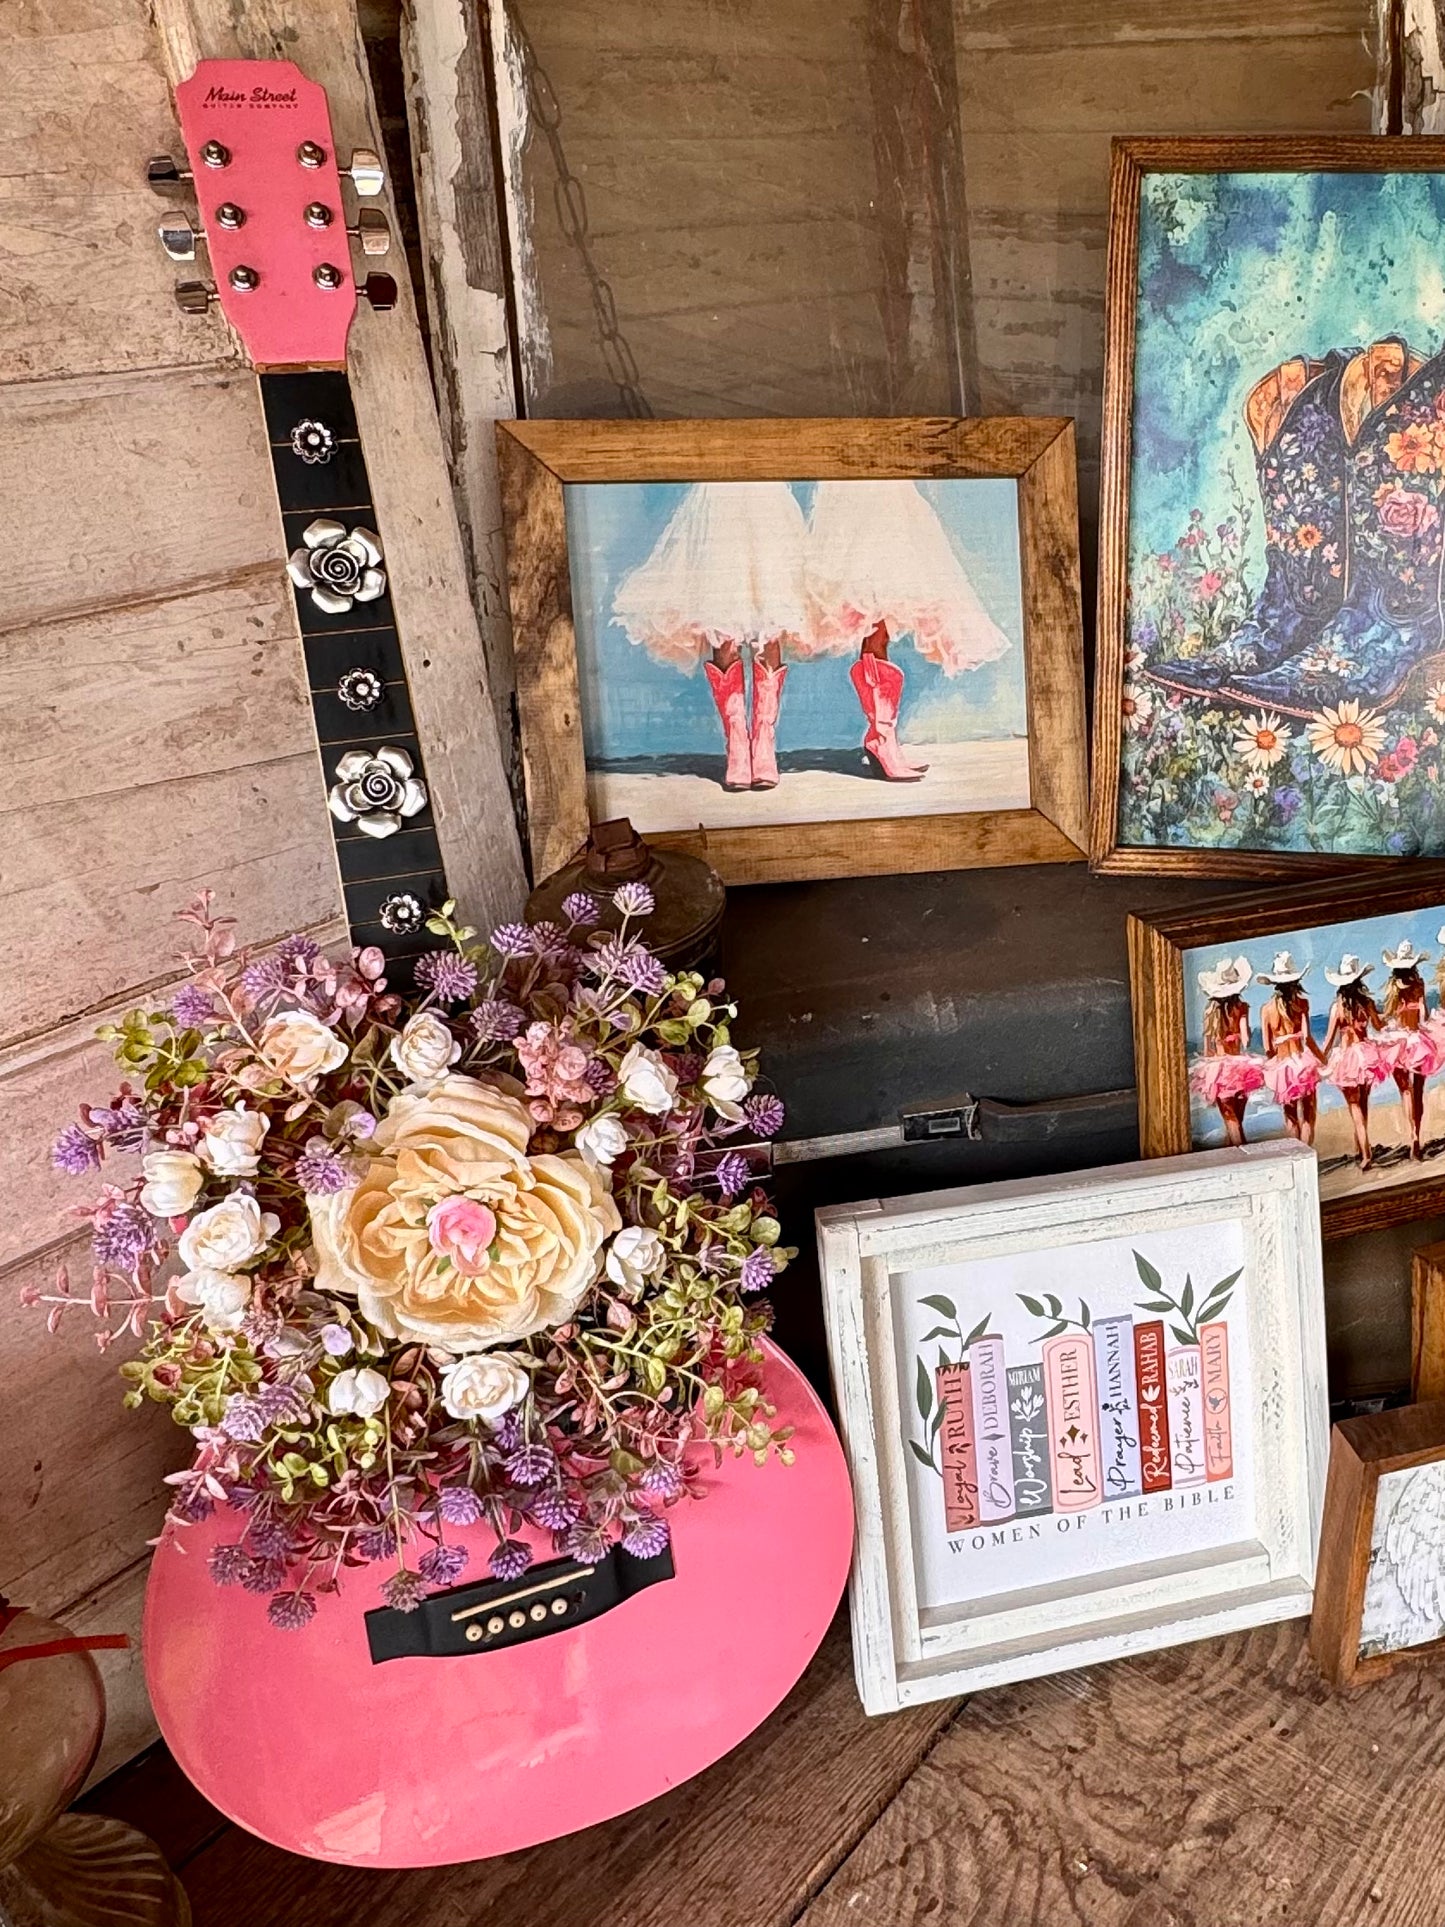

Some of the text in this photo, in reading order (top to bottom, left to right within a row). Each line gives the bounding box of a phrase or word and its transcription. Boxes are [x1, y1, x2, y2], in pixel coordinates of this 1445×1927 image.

[205, 86, 297, 102] Main Street
[978, 1344, 999, 1431] DEBORAH
[1008, 1367, 1041, 1386] MIRIAM
[1060, 1348, 1081, 1422] ESTHER
[1105, 1325, 1122, 1397] HANNAH
[1140, 1332, 1158, 1385] RAHAB
[1168, 1356, 1198, 1379] SARAH
[1206, 1334, 1222, 1384] MARY
[944, 1377, 966, 1440] RUTH
[1173, 1397, 1204, 1474] Patience
[1012, 1427, 1048, 1506] Worship
[1057, 1451, 1096, 1494] Lead
[1107, 1417, 1137, 1491] Prayer
[1140, 1402, 1170, 1483] Redeemed
[1206, 1420, 1232, 1468] Faith
[944, 1460, 979, 1511] Loyal
[982, 1446, 1012, 1509] Brave
[947, 1485, 1235, 1555] WOMEN OF THE BIBLE
